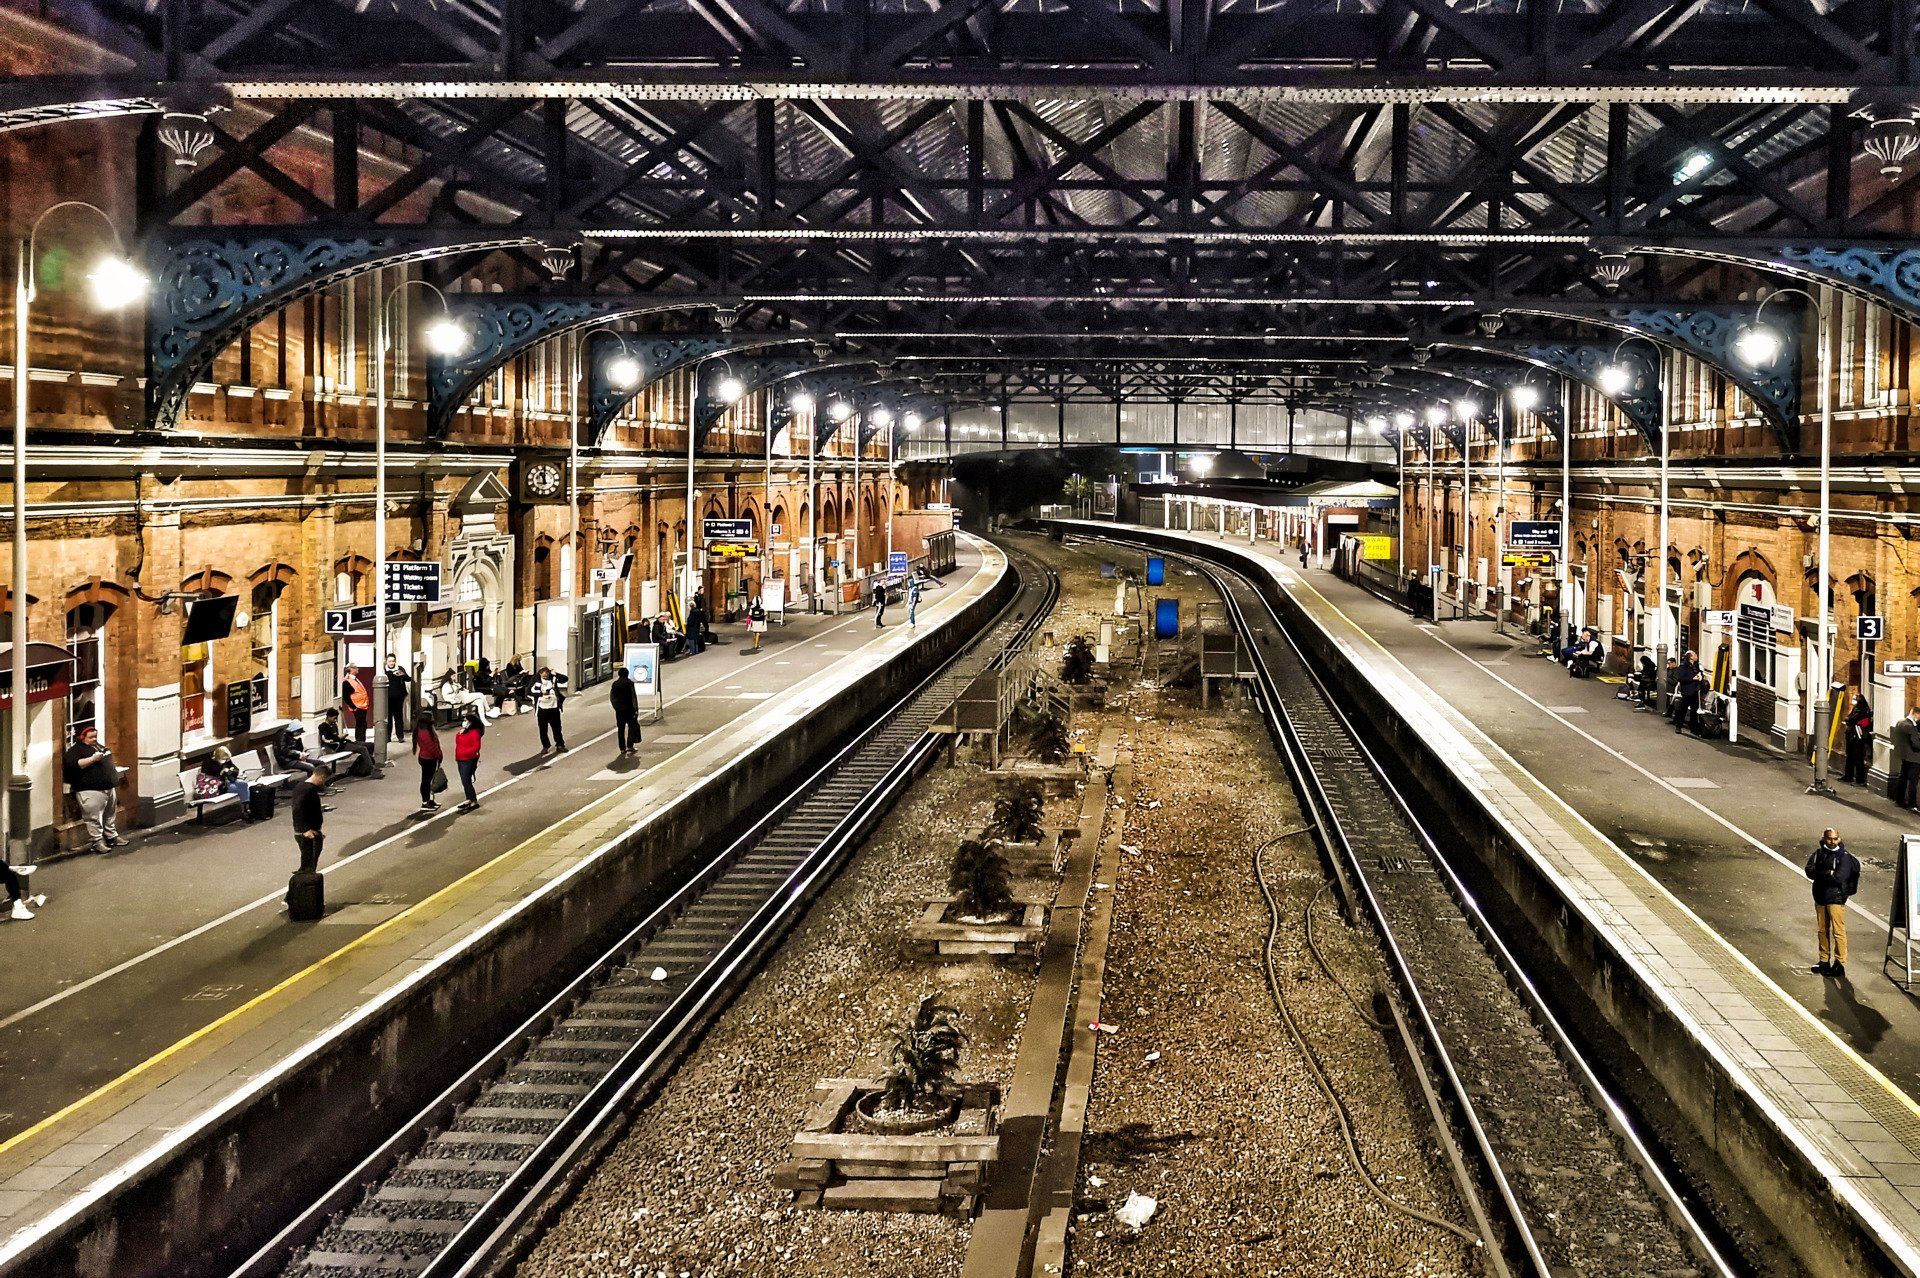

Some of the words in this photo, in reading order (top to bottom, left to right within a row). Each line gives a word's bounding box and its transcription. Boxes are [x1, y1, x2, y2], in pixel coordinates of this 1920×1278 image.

[403, 593, 416, 601] Way
[331, 613, 344, 631] 2
[1863, 619, 1877, 637] 3
